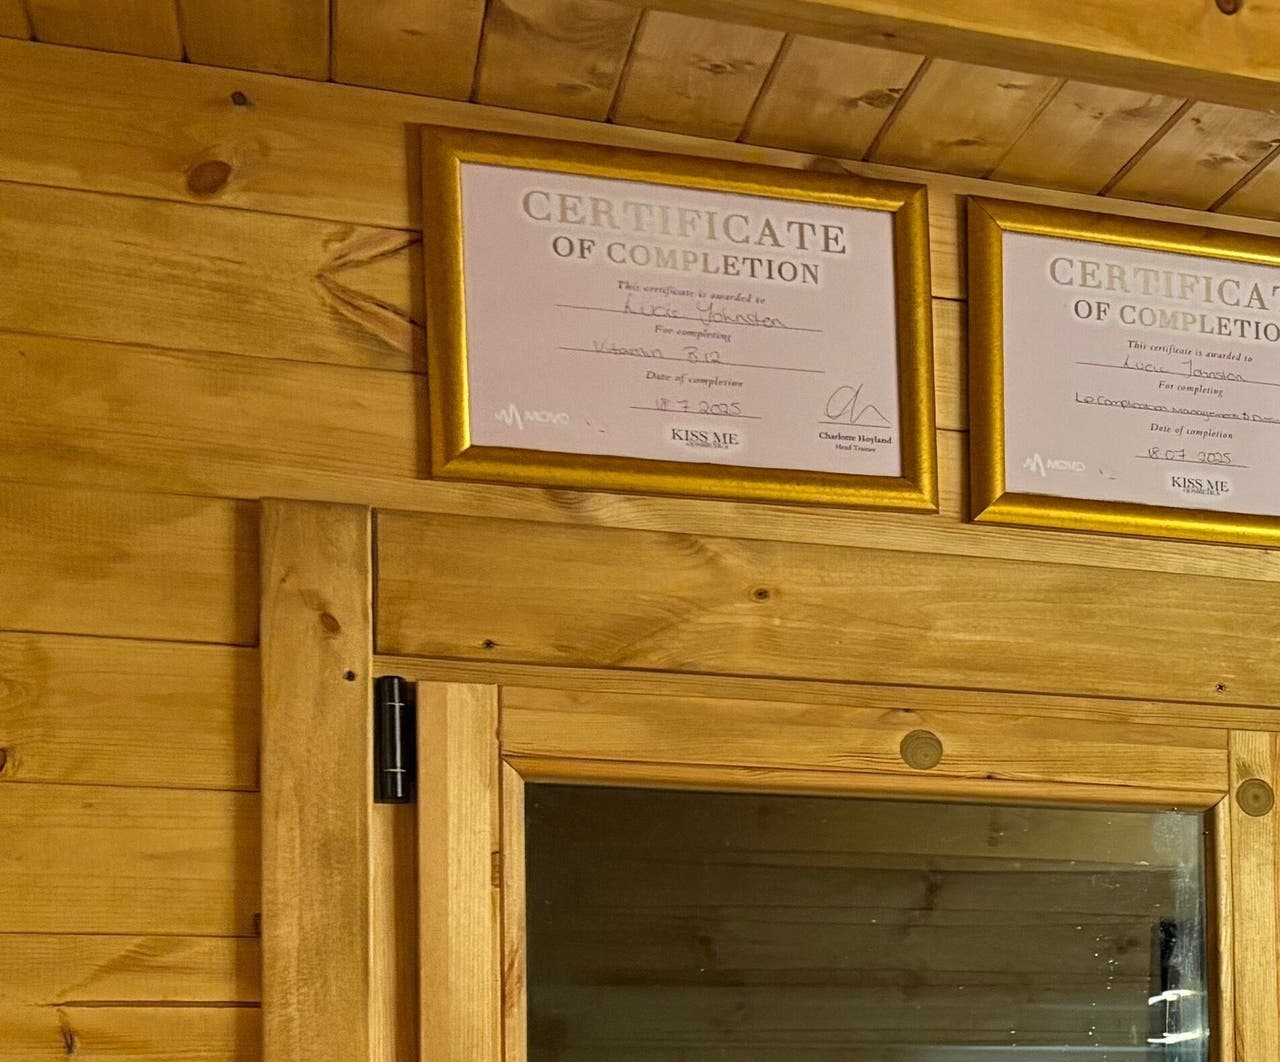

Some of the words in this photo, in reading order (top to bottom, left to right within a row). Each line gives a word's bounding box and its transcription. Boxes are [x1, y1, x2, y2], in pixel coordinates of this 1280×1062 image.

[522, 191, 846, 254] CERTIFICATE
[552, 235, 596, 259] OF
[607, 242, 820, 284] COMPLETION
[617, 280, 641, 291] This
[643, 285, 695, 299] certificate
[710, 293, 752, 303] awarded
[1074, 299, 1110, 321] OF
[655, 325, 674, 334] For
[676, 329, 732, 343] completing
[1127, 340, 1147, 350] This
[1150, 344, 1192, 357] certificate
[1206, 350, 1241, 362] awarded
[1244, 354, 1253, 363] to
[646, 371, 671, 382] Date
[674, 374, 686, 385] of
[688, 377, 744, 389] completion
[1158, 380, 1174, 390] For
[1176, 384, 1224, 398] completing
[672, 428, 709, 443] KISS
[713, 432, 741, 446] ME
[858, 434, 892, 445] Hoyland
[1150, 423, 1172, 433] Date
[1174, 425, 1184, 437] of
[1186, 428, 1233, 440] completion
[1171, 476, 1203, 489] KISS
[1206, 479, 1230, 493] ME
